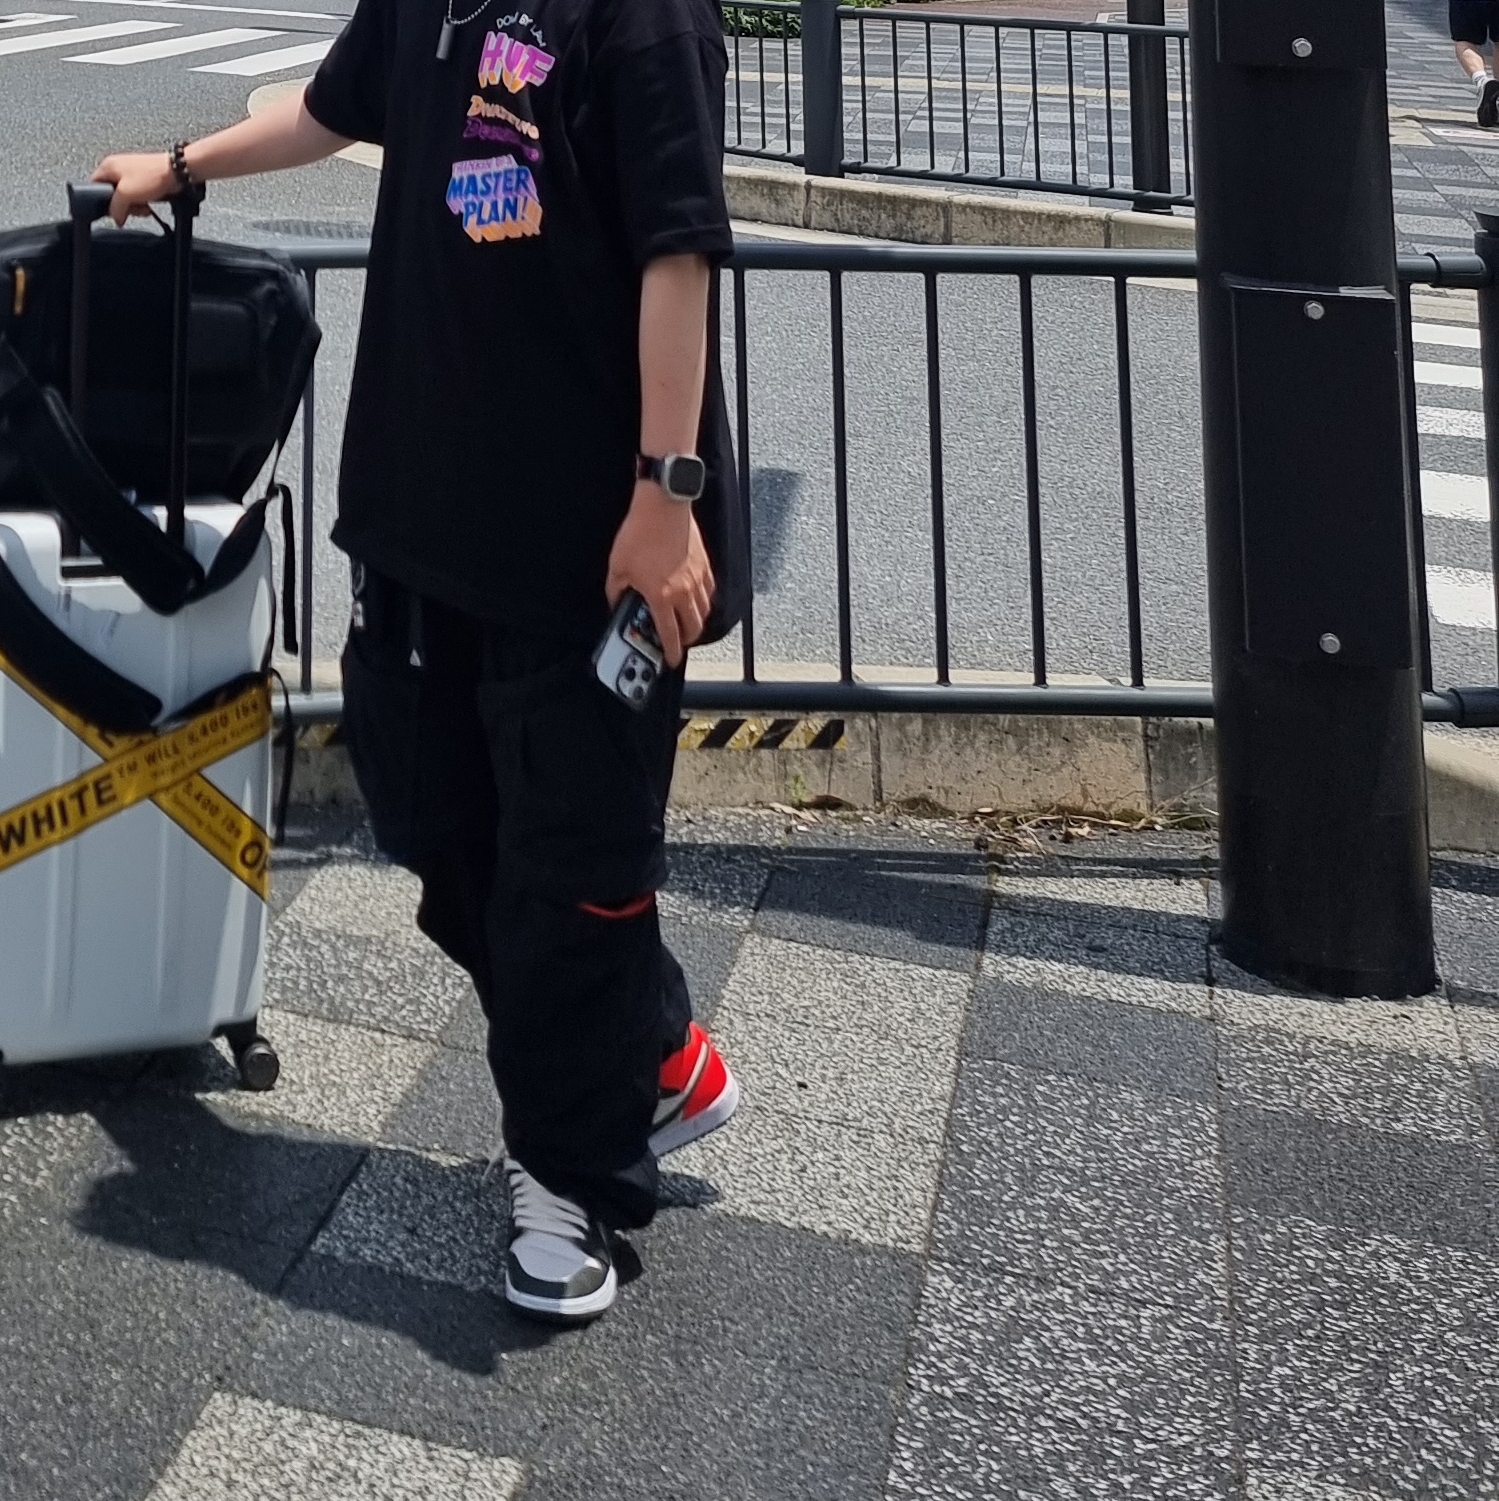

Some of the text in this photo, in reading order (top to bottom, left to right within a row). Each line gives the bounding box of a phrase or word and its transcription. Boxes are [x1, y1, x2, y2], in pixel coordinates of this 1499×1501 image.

[518, 13, 534, 26] BY
[477, 30, 556, 94] HUF
[445, 165, 531, 202] MASTER
[462, 196, 529, 228] PLAN!
